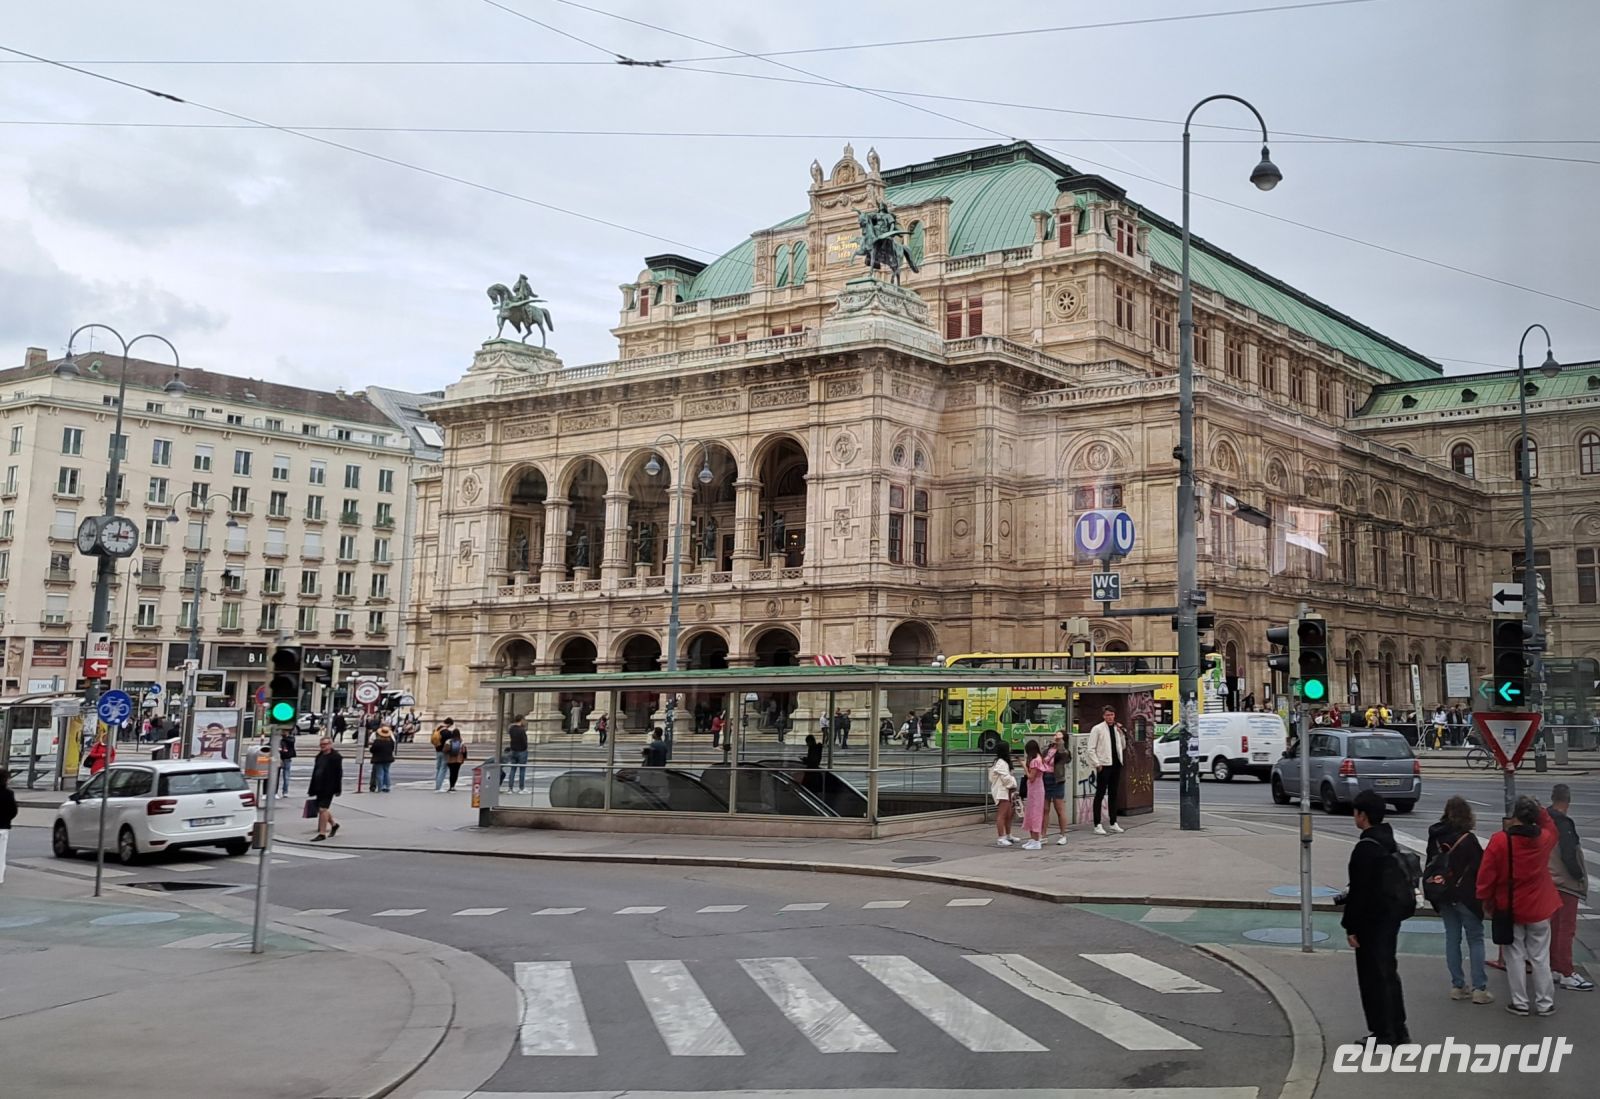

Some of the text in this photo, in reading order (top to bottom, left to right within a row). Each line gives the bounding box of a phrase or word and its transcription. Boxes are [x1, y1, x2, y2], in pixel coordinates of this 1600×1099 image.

[1081, 519, 1105, 550] U
[1116, 519, 1132, 550] U
[1094, 575, 1118, 588] WC
[324, 654, 357, 664] PAZA
